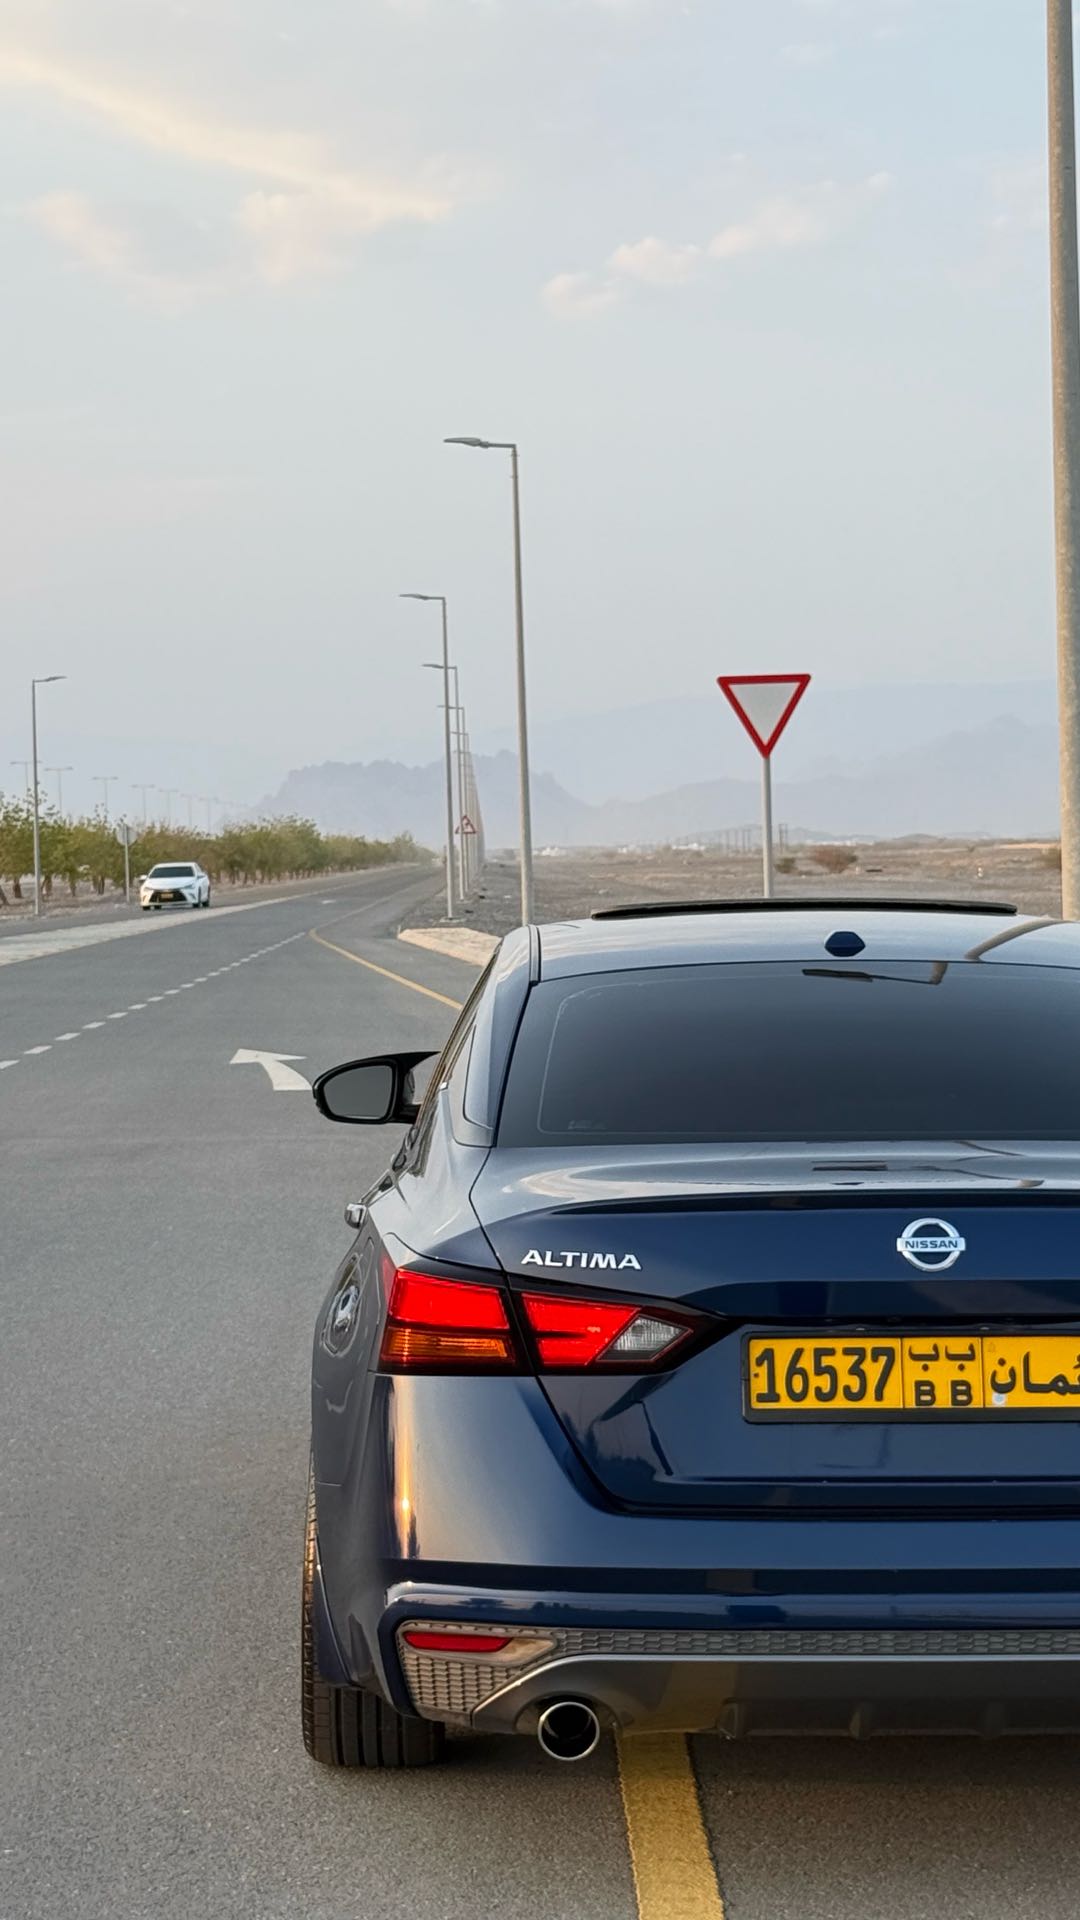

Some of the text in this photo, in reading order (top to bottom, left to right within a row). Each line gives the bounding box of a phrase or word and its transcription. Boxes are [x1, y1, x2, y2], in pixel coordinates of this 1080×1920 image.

[905, 1240, 958, 1249] NISSAN
[521, 1249, 642, 1270] ALTIMA
[755, 1347, 896, 1402] 16537
